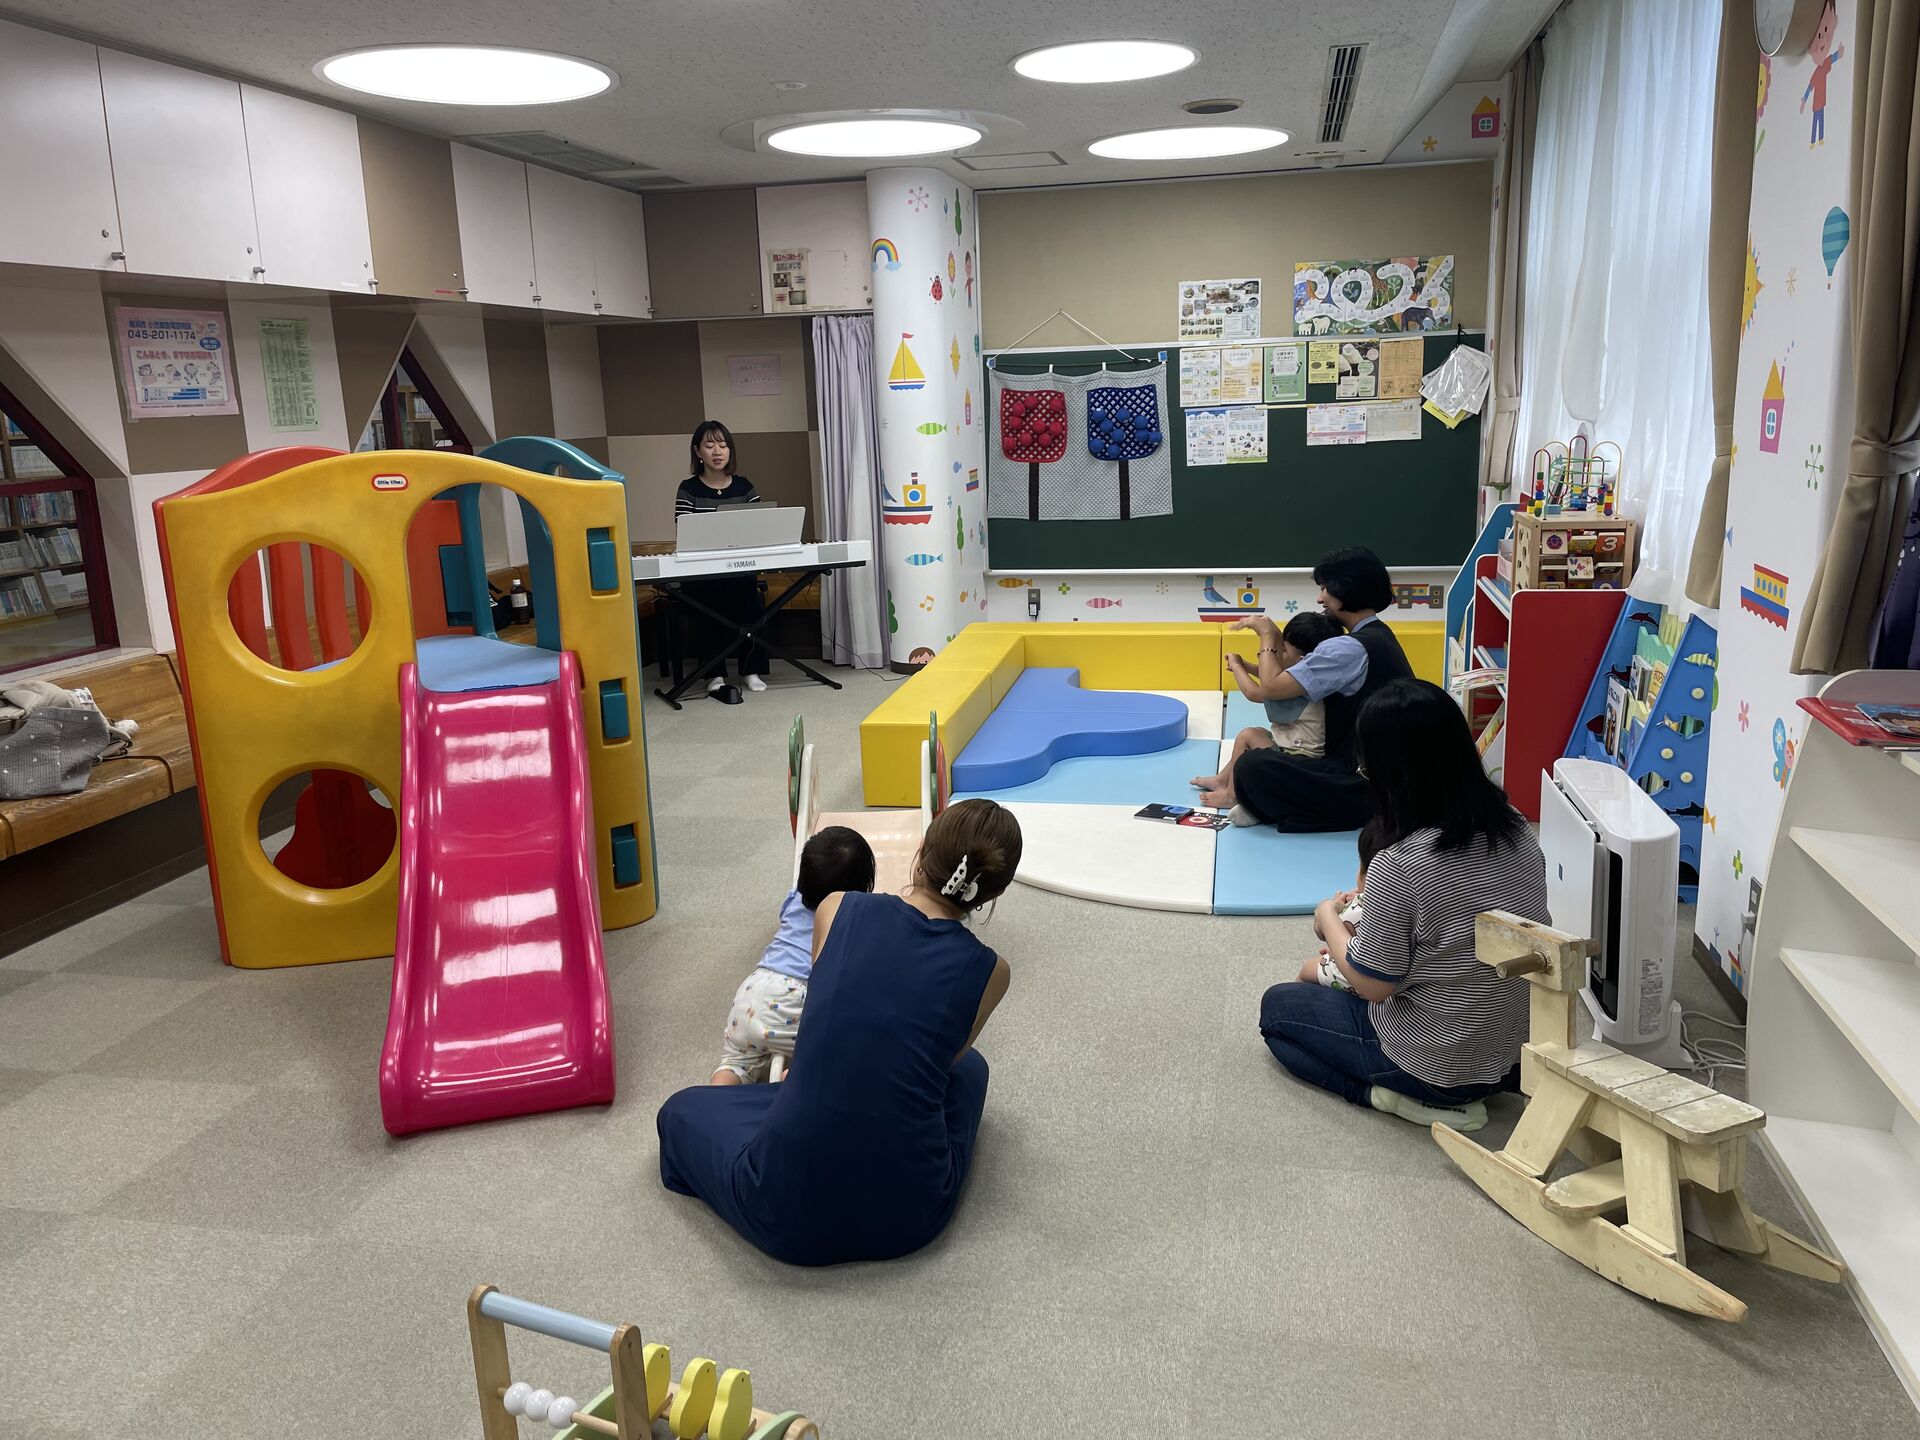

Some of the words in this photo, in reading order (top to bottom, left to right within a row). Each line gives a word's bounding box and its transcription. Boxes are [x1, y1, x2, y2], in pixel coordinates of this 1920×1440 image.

[1294, 254, 1454, 323] 2026
[128, 330, 196, 341] 045-201-1174
[1601, 536, 1618, 551] 3
[733, 560, 756, 568] YAMAHA
